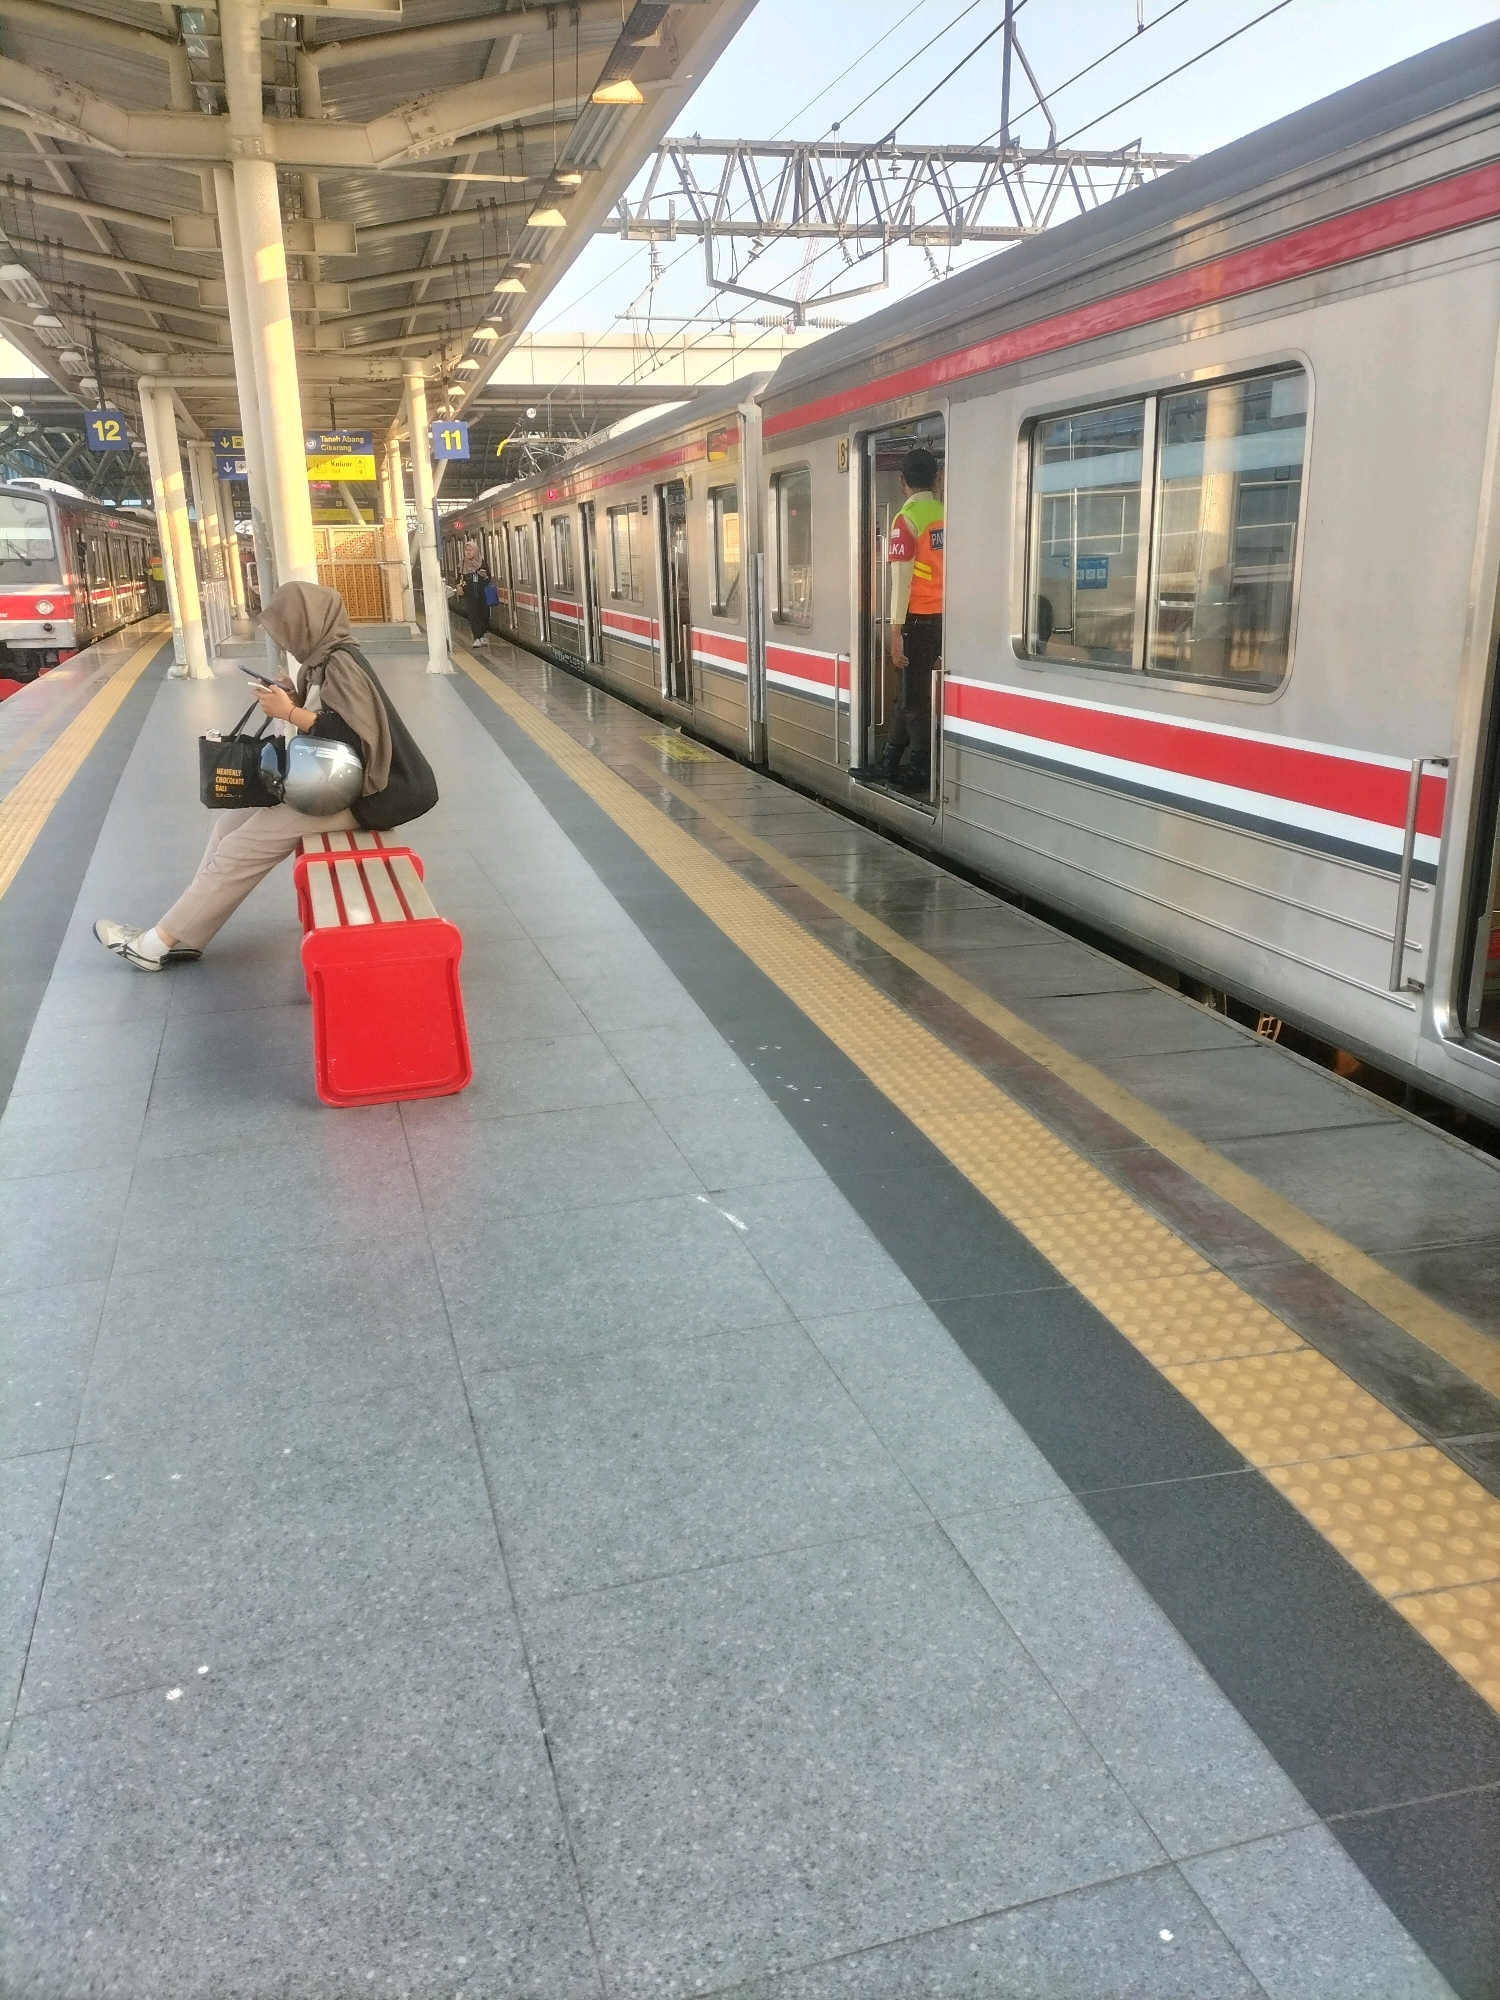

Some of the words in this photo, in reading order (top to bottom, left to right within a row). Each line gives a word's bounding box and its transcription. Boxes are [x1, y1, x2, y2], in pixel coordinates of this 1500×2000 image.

[92, 420, 122, 441] 12
[320, 435, 341, 443] Tanah
[342, 435, 365, 444] Abang
[440, 429, 462, 450] 11
[320, 444, 352, 453] Cikarang
[216, 767, 242, 777] HEAVENLY
[215, 776, 245, 785] CHOCOLATE
